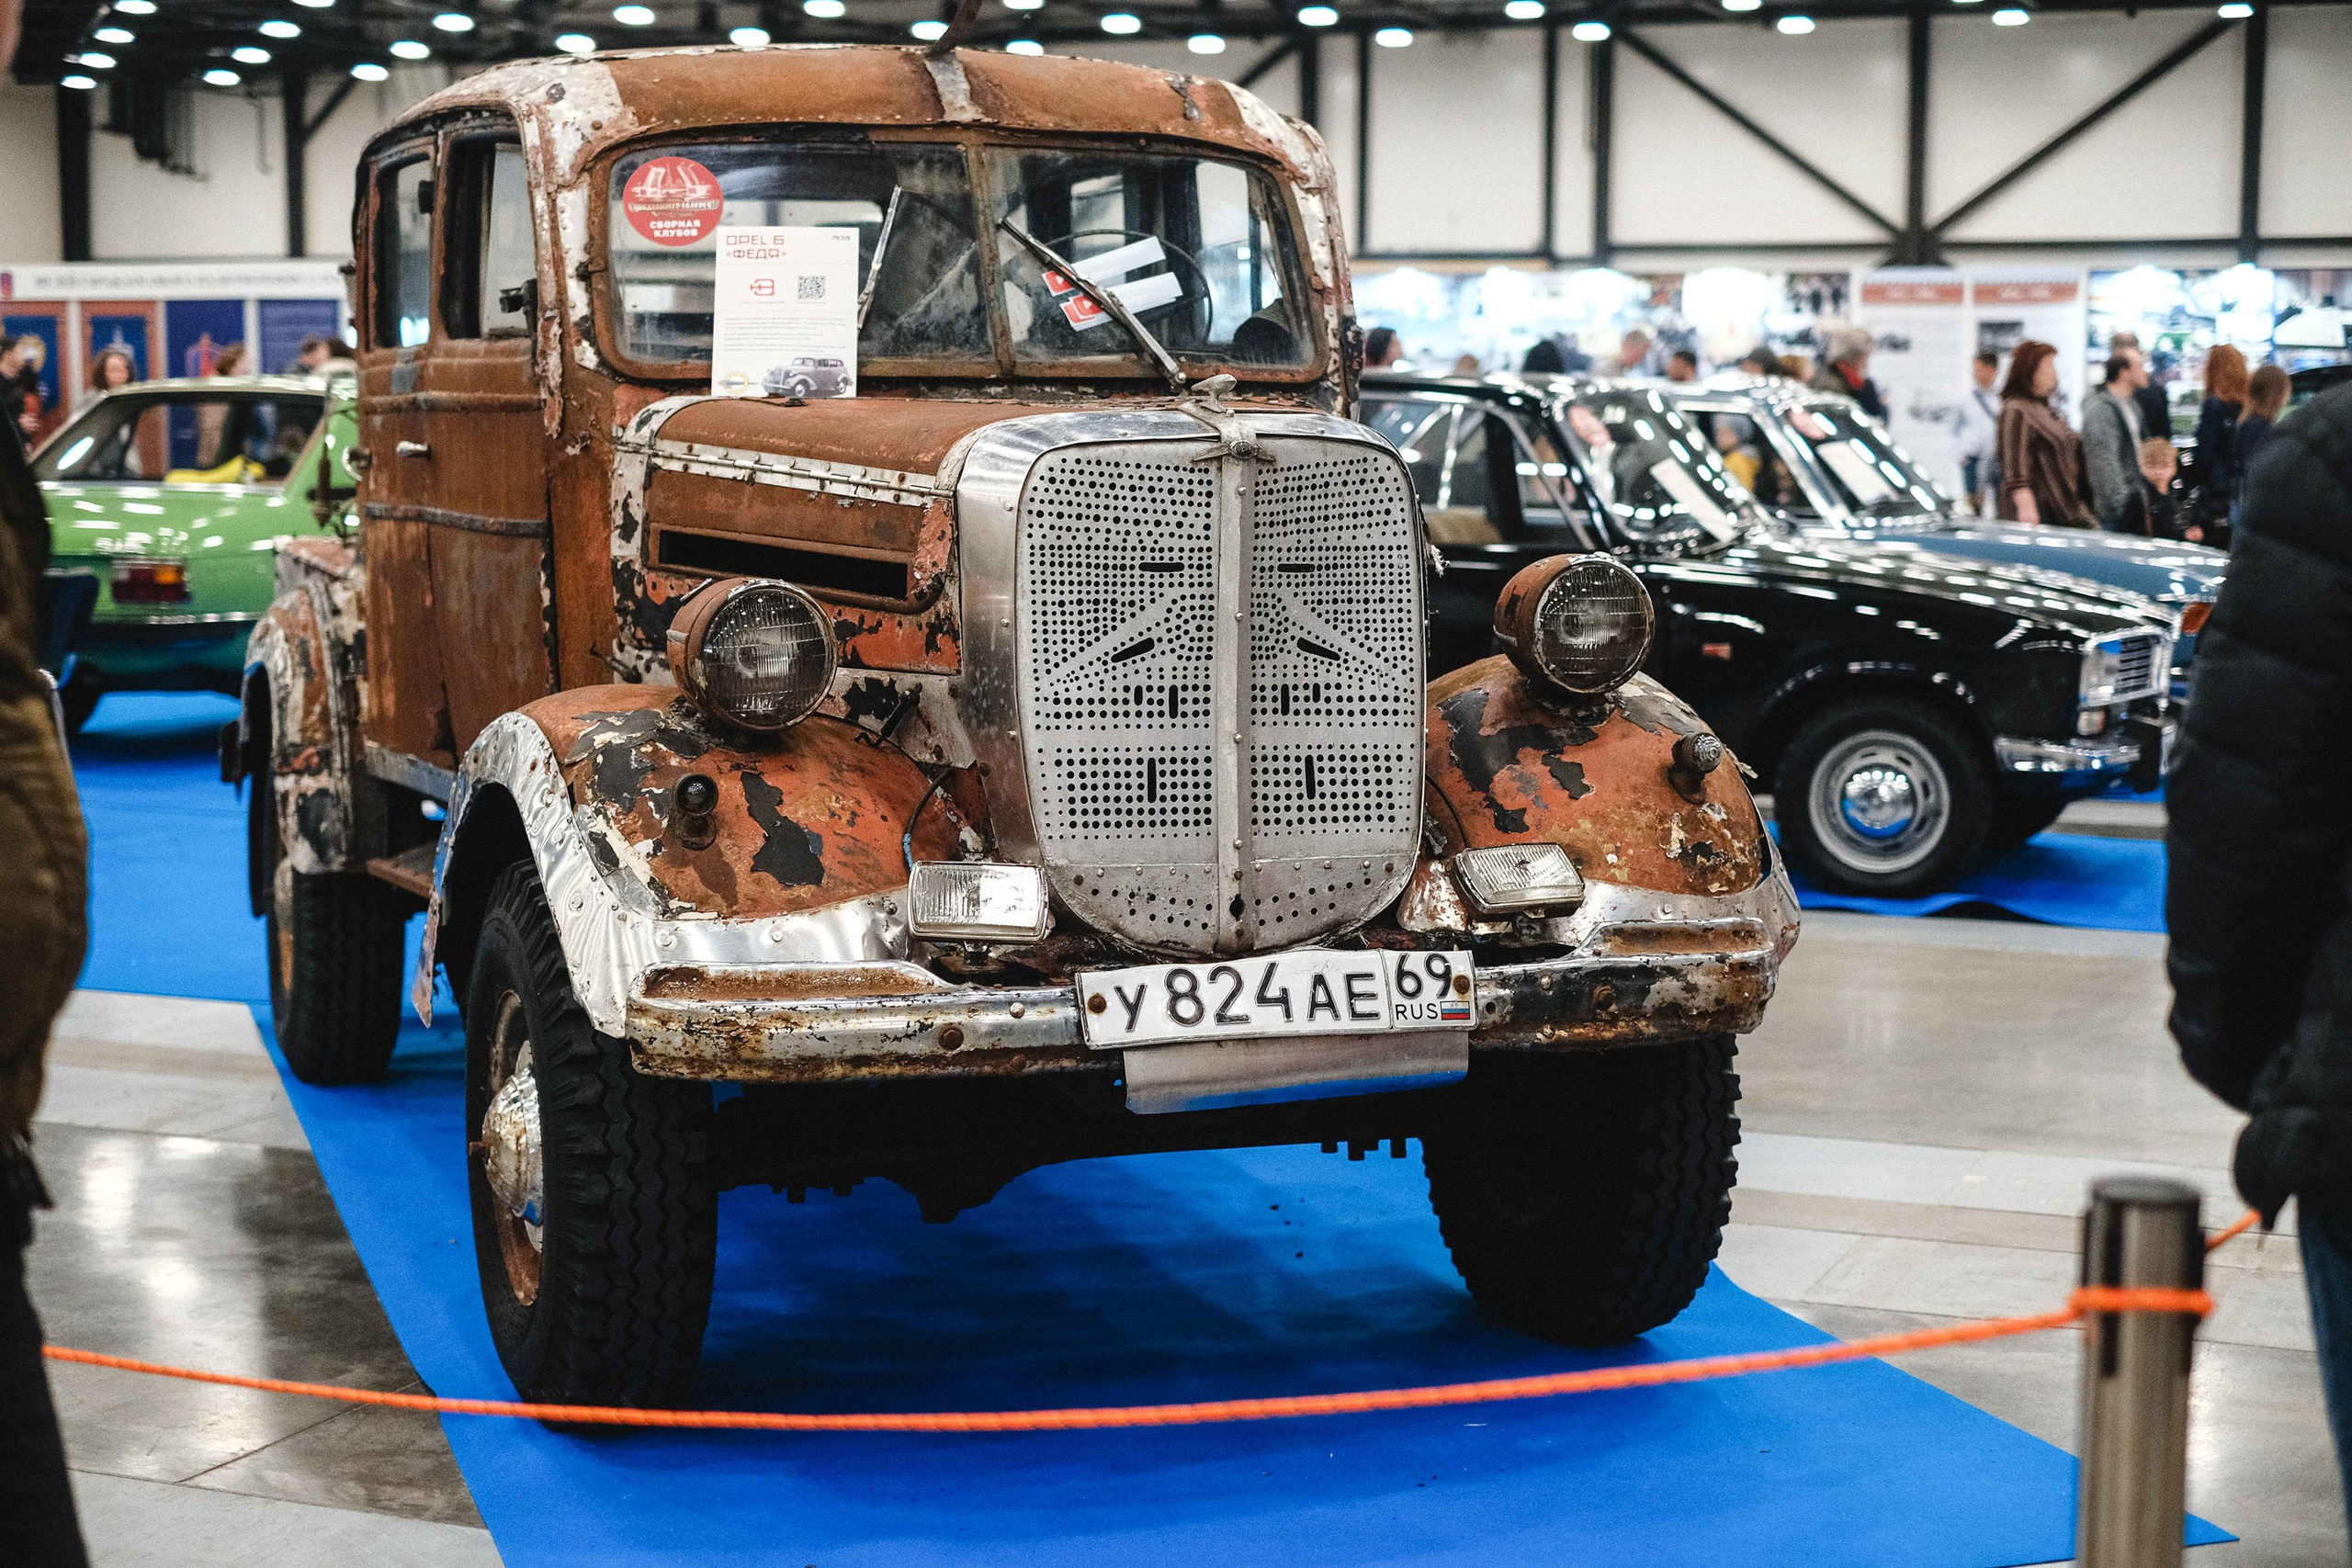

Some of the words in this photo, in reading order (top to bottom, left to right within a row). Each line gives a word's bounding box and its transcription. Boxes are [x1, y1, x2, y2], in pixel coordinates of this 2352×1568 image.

[650, 220, 701, 230] СБОРНАЯ
[653, 229, 698, 238] КЛУБОВ
[726, 235, 767, 245] OPEL
[726, 249, 787, 259] «ФЕДЯ»
[1395, 953, 1453, 999] 69
[1396, 1003, 1438, 1021] RUS
